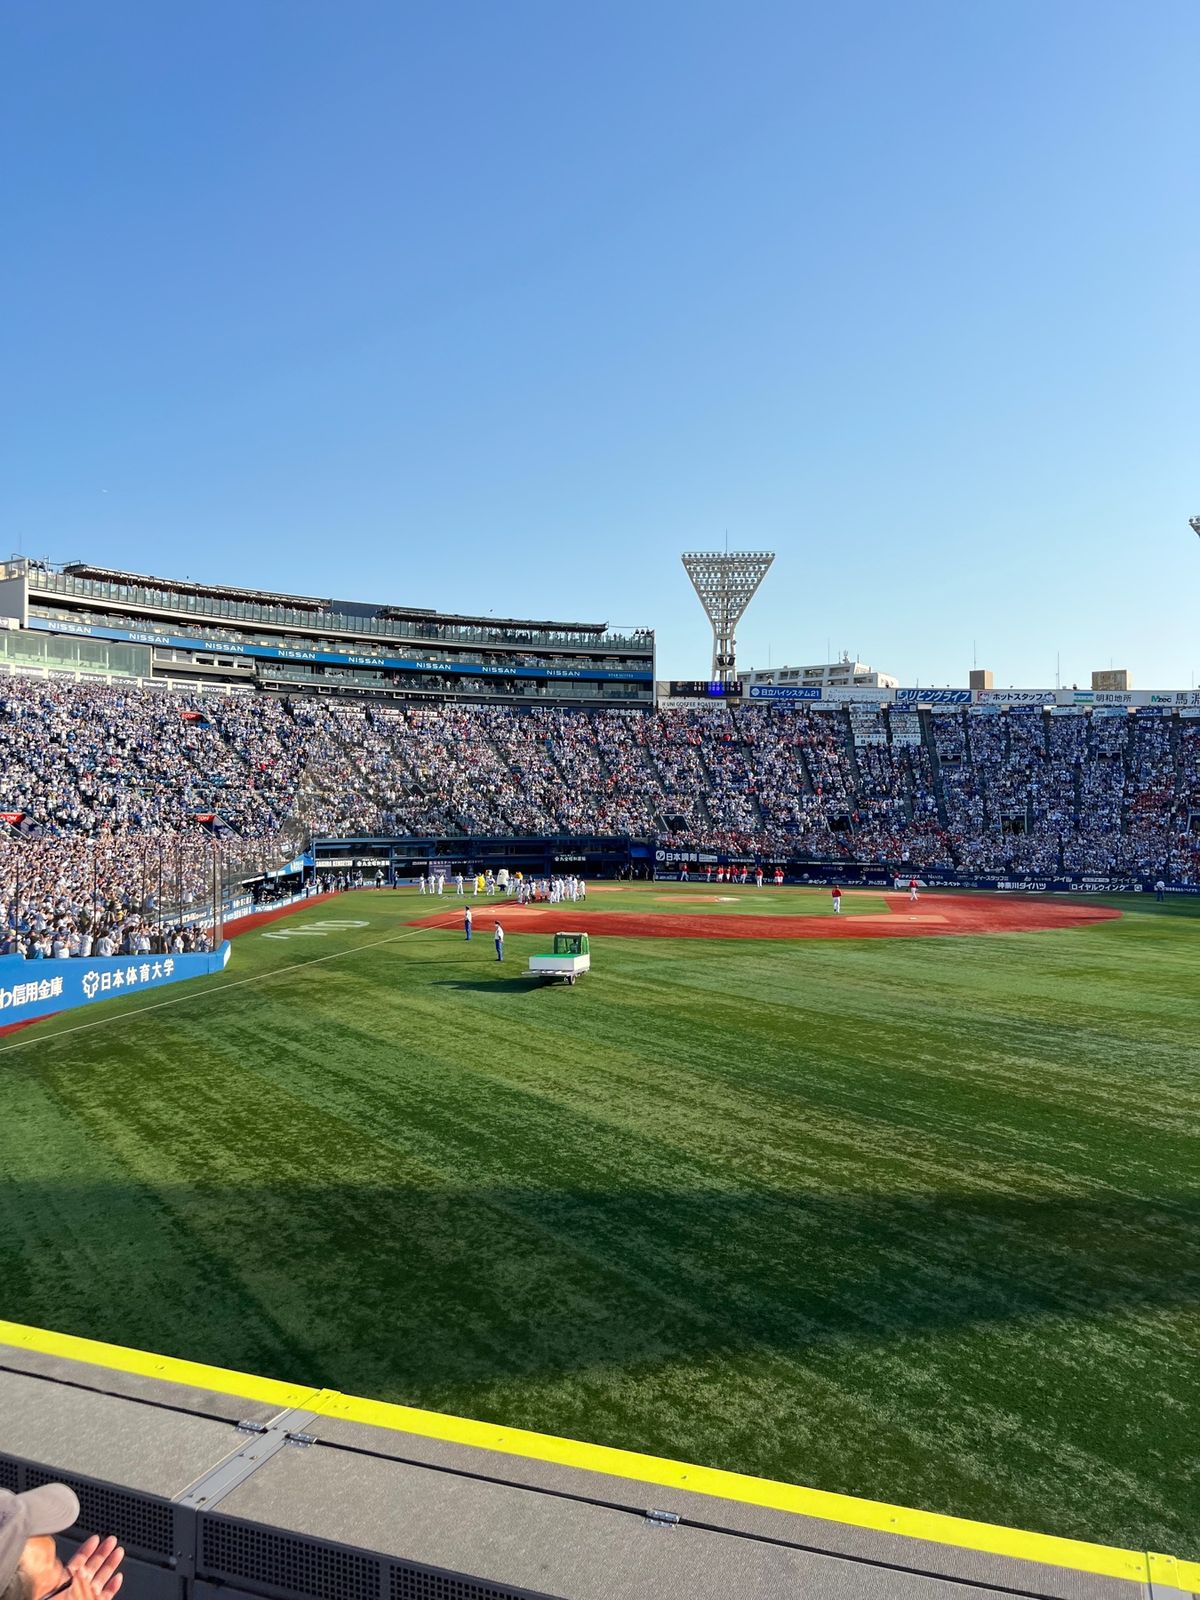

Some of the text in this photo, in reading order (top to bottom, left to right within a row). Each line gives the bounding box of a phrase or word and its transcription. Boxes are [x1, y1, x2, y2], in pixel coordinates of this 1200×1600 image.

[48, 622, 92, 634] NISSAN
[129, 633, 170, 644] NISSAN
[205, 642, 244, 652] NISSAN
[278, 650, 316, 659] NISSAN
[348, 656, 385, 666] NISSAN
[416, 662, 451, 670] NISSAN
[482, 666, 517, 674] NISSAN
[761, 689, 819, 697] 日立ハイシステム21
[908, 690, 970, 702] リビングライフ
[993, 692, 1043, 701] ホットスタッフ
[1095, 694, 1132, 703] 明和地所
[665, 853, 698, 862] 日本調剤
[997, 881, 1047, 890] 神奈川ダイハツ
[1071, 883, 1129, 892] ロイヤルウイング
[101, 958, 174, 992] 日本体育大学
